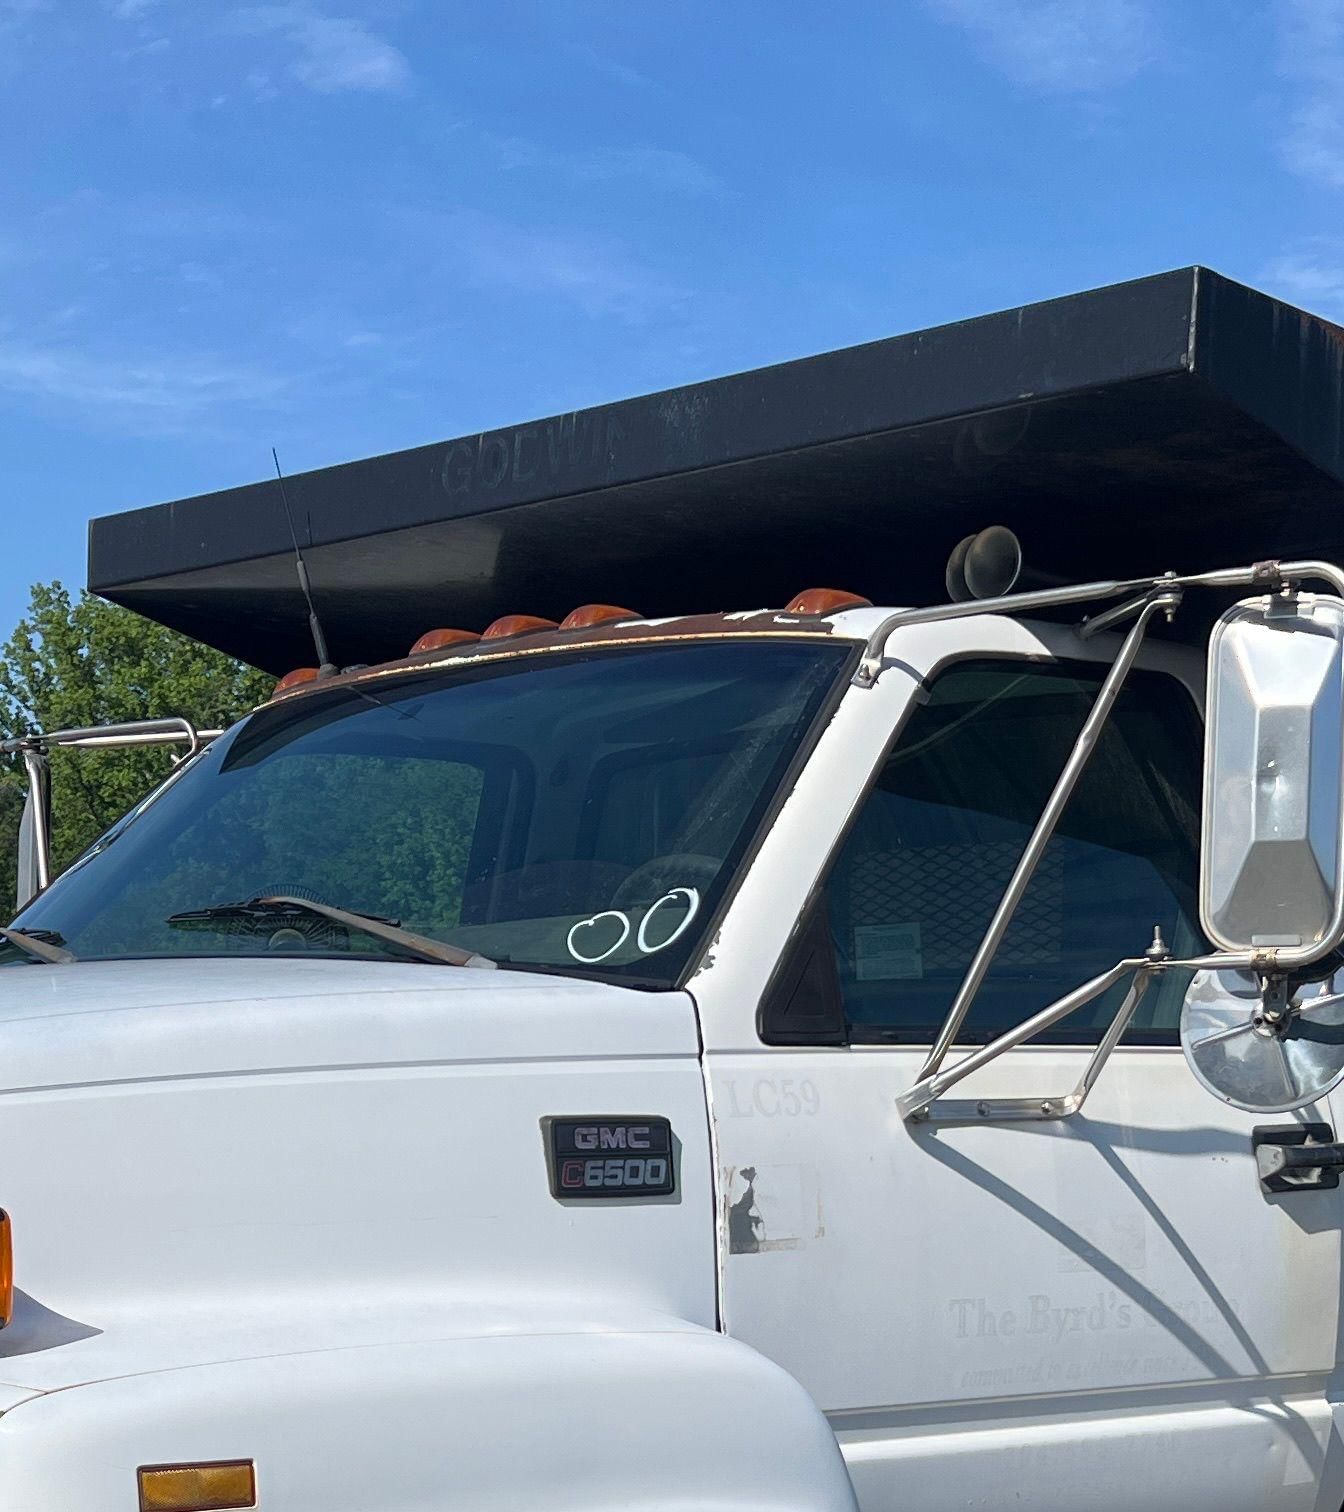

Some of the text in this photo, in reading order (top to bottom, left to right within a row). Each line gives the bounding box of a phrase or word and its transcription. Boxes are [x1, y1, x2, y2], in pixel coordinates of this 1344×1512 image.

[720, 1079, 821, 1118] LC59
[574, 1126, 651, 1149] GMC
[561, 1158, 667, 1188] C6500
[949, 1298, 1016, 1339] The
[1026, 1292, 1132, 1343] Byrd's
